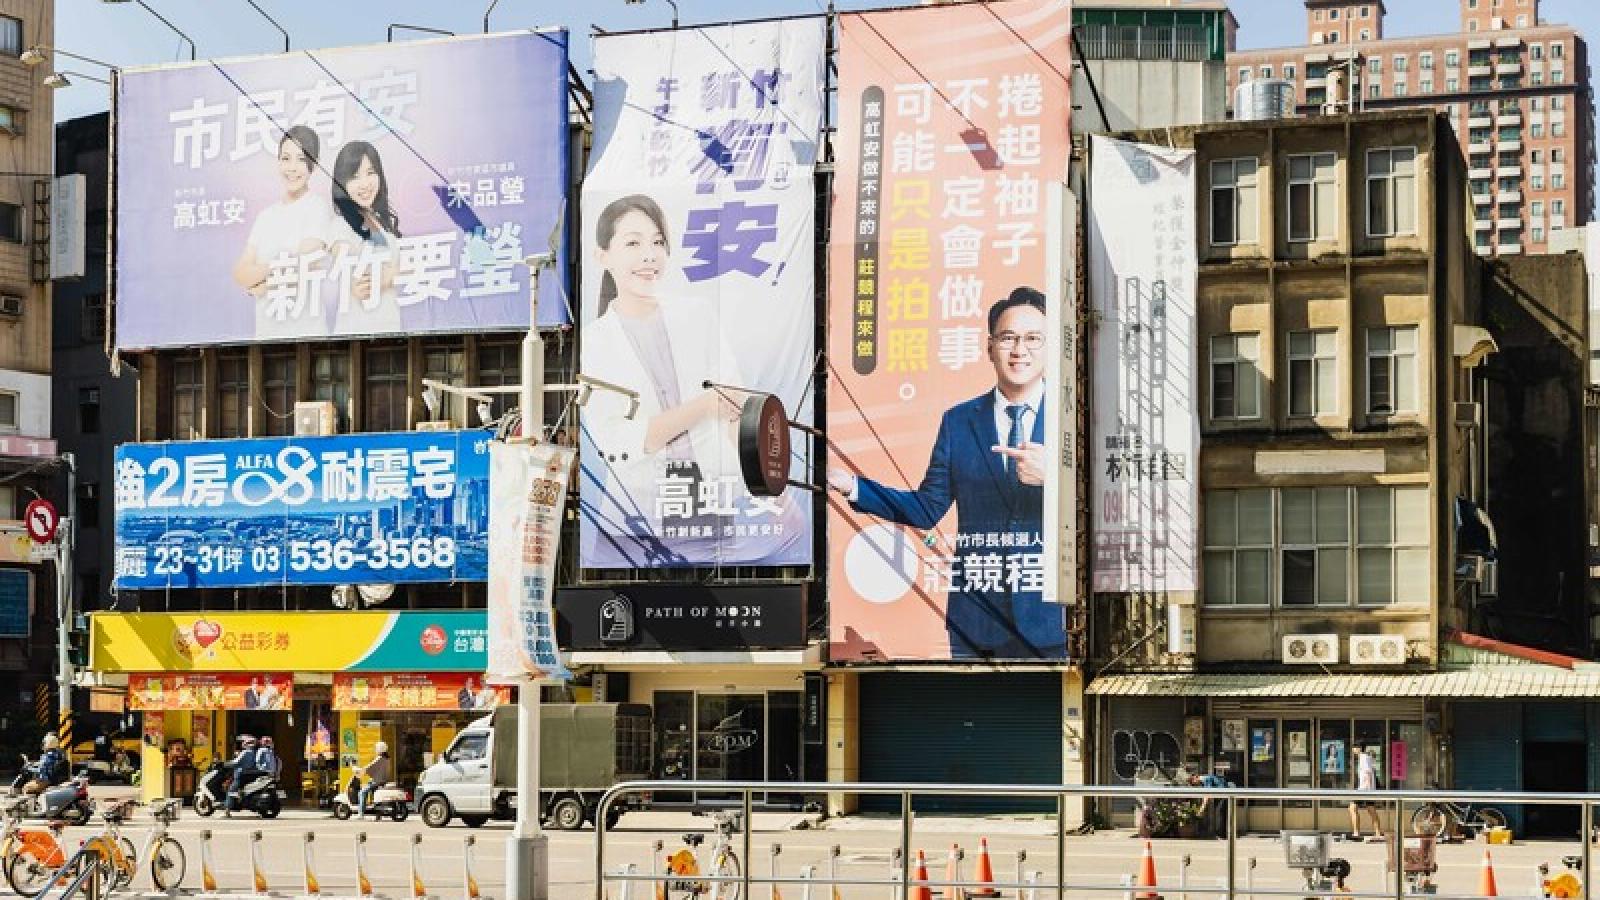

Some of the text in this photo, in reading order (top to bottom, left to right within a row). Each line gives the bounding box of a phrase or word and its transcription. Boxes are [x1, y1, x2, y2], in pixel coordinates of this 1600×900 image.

[169, 68, 416, 169] 市民有安
[989, 73, 1043, 266] 捲起袖子
[173, 196, 247, 229] 高虹安
[938, 76, 990, 371] 不一定會做事
[236, 454, 276, 470] ALFA
[321, 445, 456, 503] 耐震宅
[252, 546, 280, 573] 03
[291, 537, 456, 571] 536-3568
[923, 551, 1044, 593] 莊競程
[645, 605, 761, 619] PATH OF MOON
[221, 631, 290, 651] 公益彩券
[453, 636, 487, 653] 台灣
